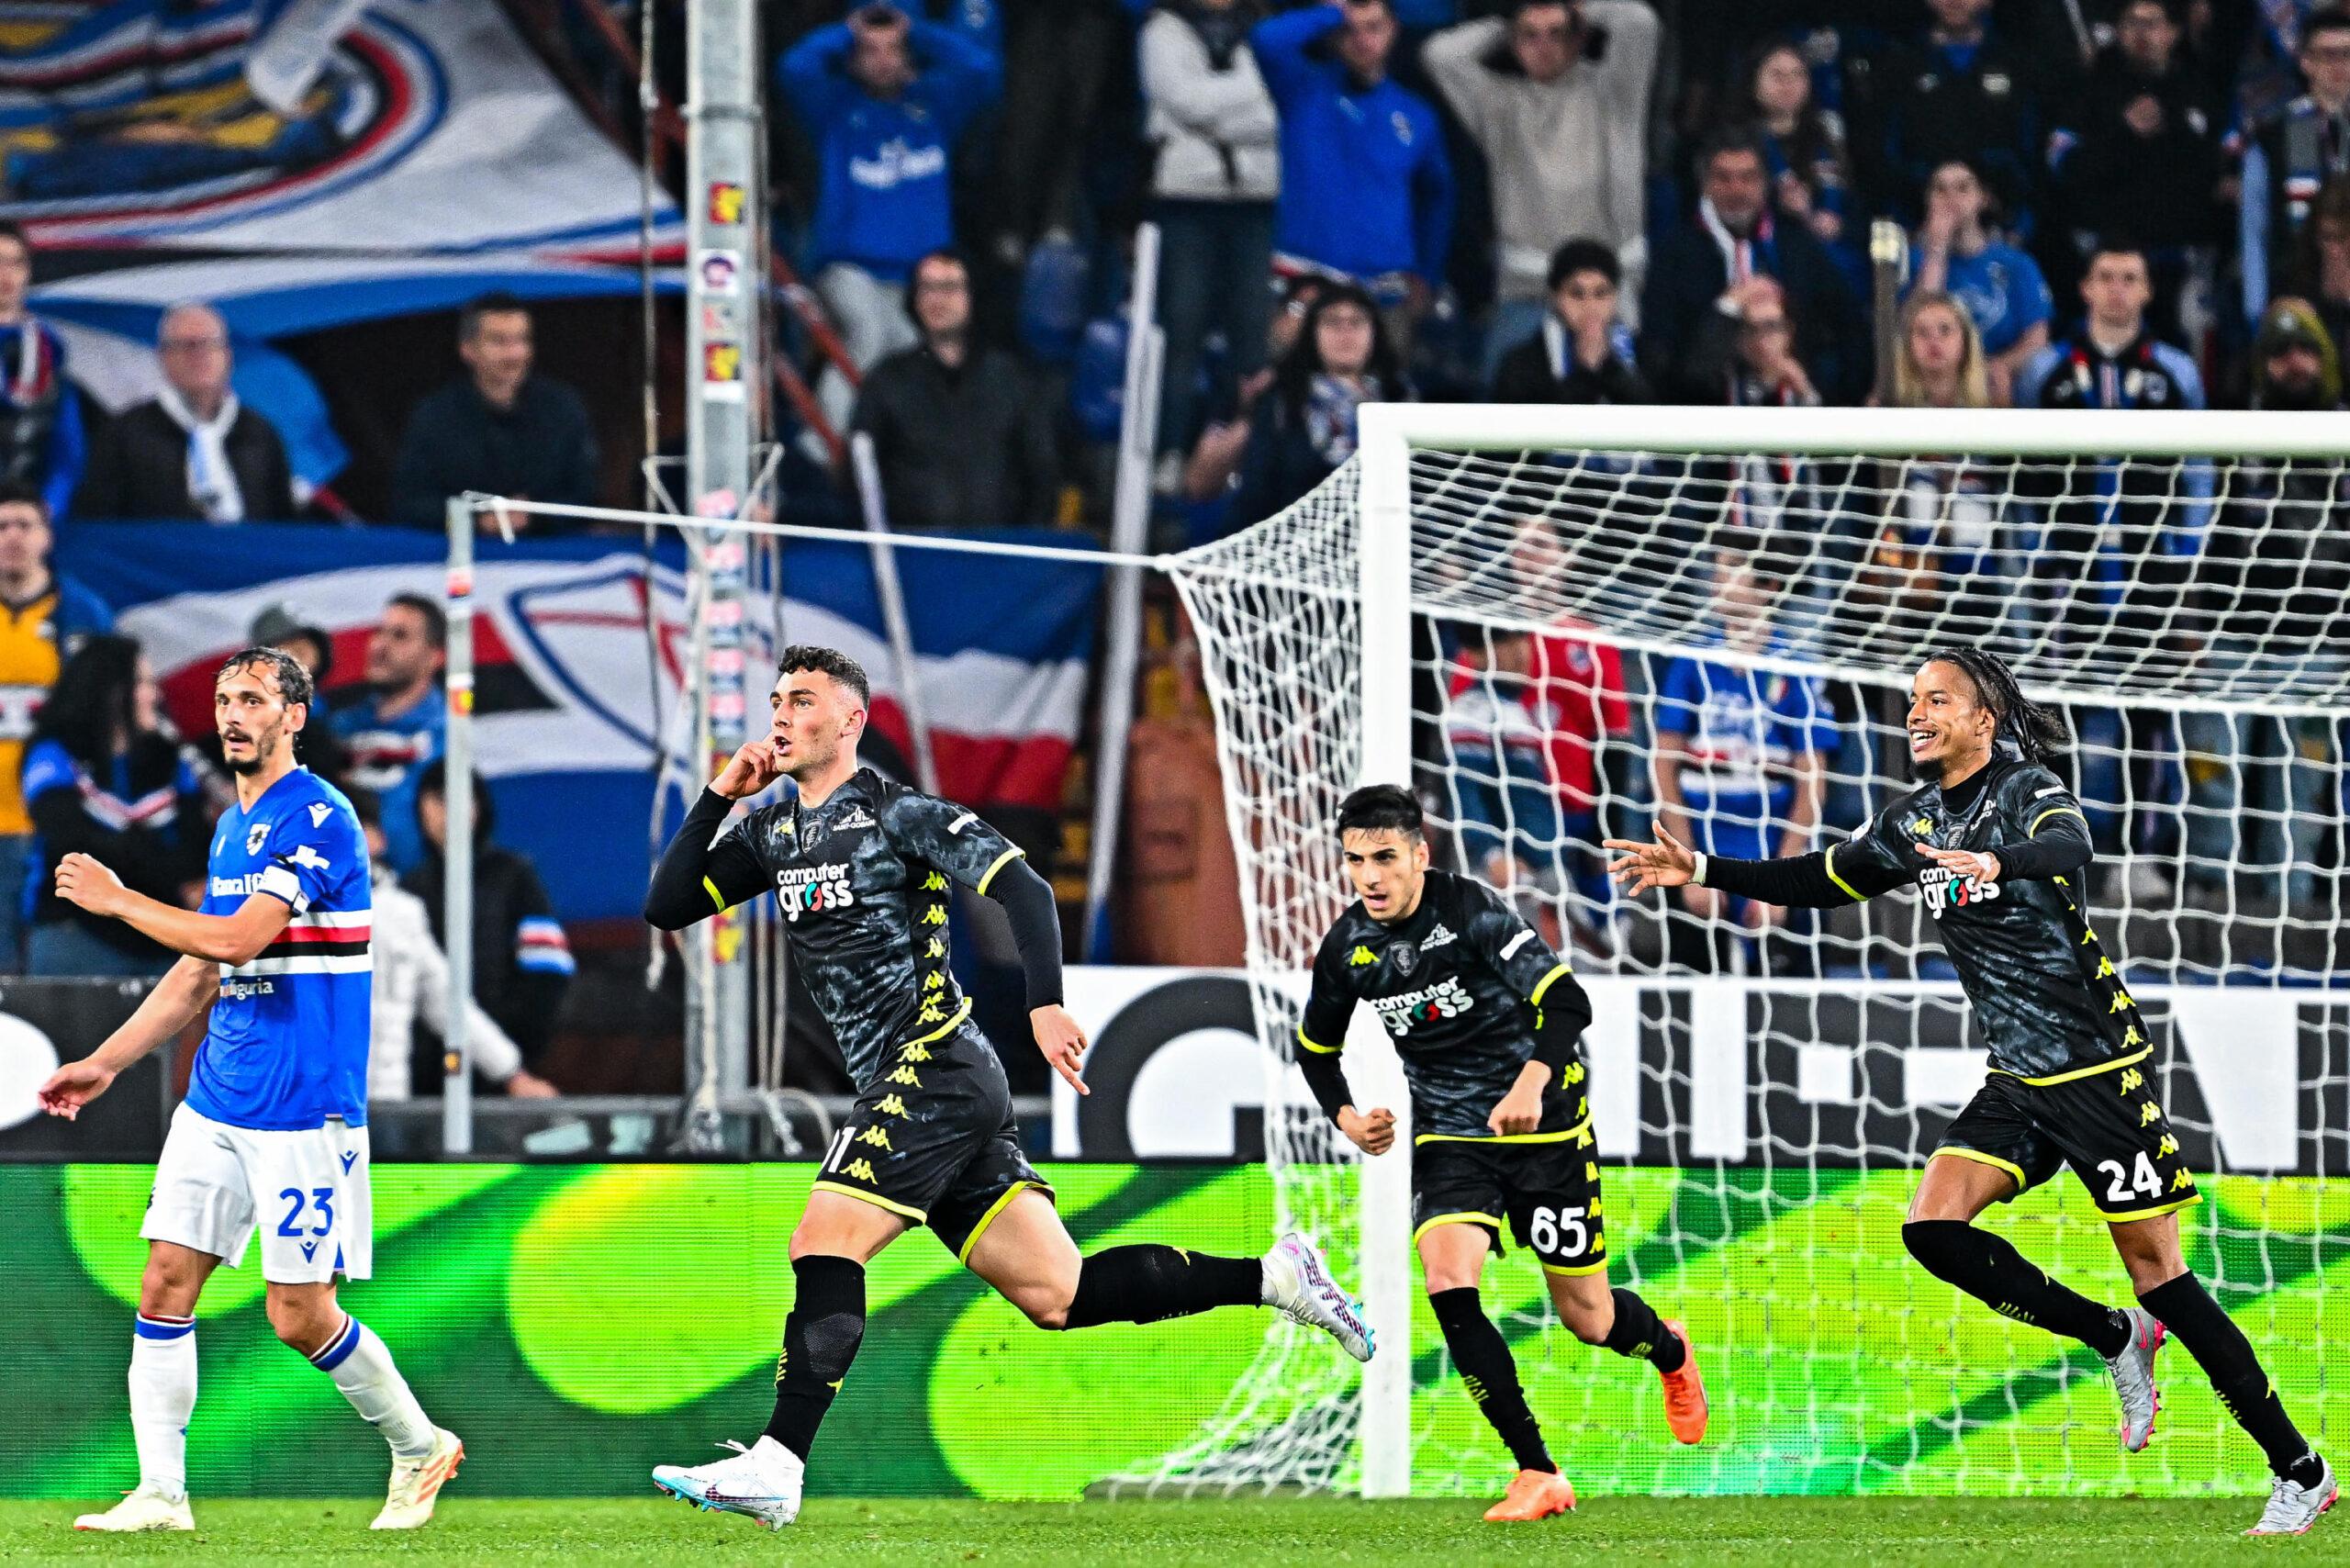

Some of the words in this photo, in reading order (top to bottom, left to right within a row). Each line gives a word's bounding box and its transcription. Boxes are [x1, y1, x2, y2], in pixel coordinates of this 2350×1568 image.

[777, 862, 850, 885] computer
[779, 879, 855, 922] gross
[1371, 976, 1459, 1011] computer
[1379, 988, 1474, 1036] gross
[2097, 1150, 2164, 1203] 24
[277, 1187, 334, 1237] 23
[1530, 1205, 1587, 1258] 65
